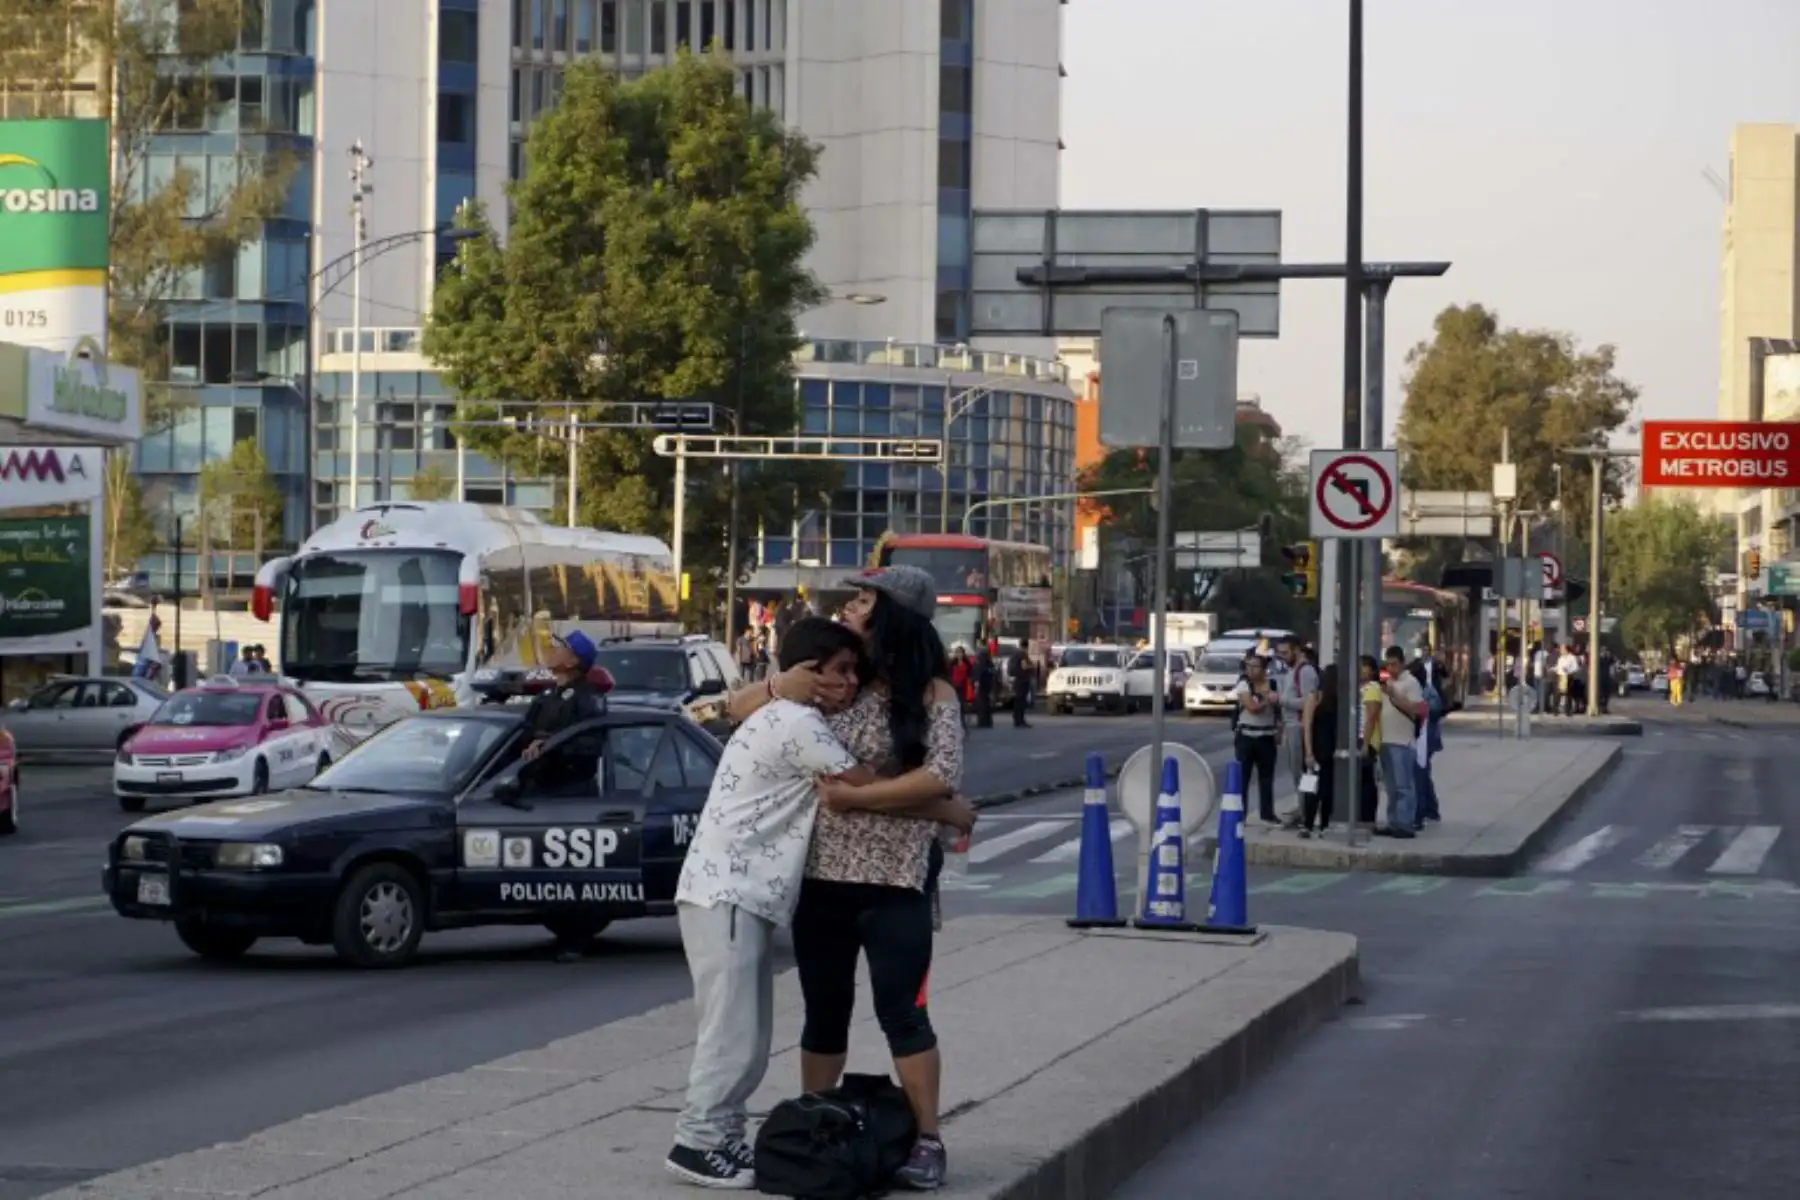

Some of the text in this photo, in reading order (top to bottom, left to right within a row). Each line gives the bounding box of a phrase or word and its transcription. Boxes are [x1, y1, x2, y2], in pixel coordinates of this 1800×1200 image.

[5, 309, 48, 327] 0125
[1659, 431, 1790, 451] EXCLUSIVO
[1659, 457, 1789, 478] METROBUS
[542, 827, 619, 868] SSP
[499, 882, 645, 901] POLICIA AUXILI
